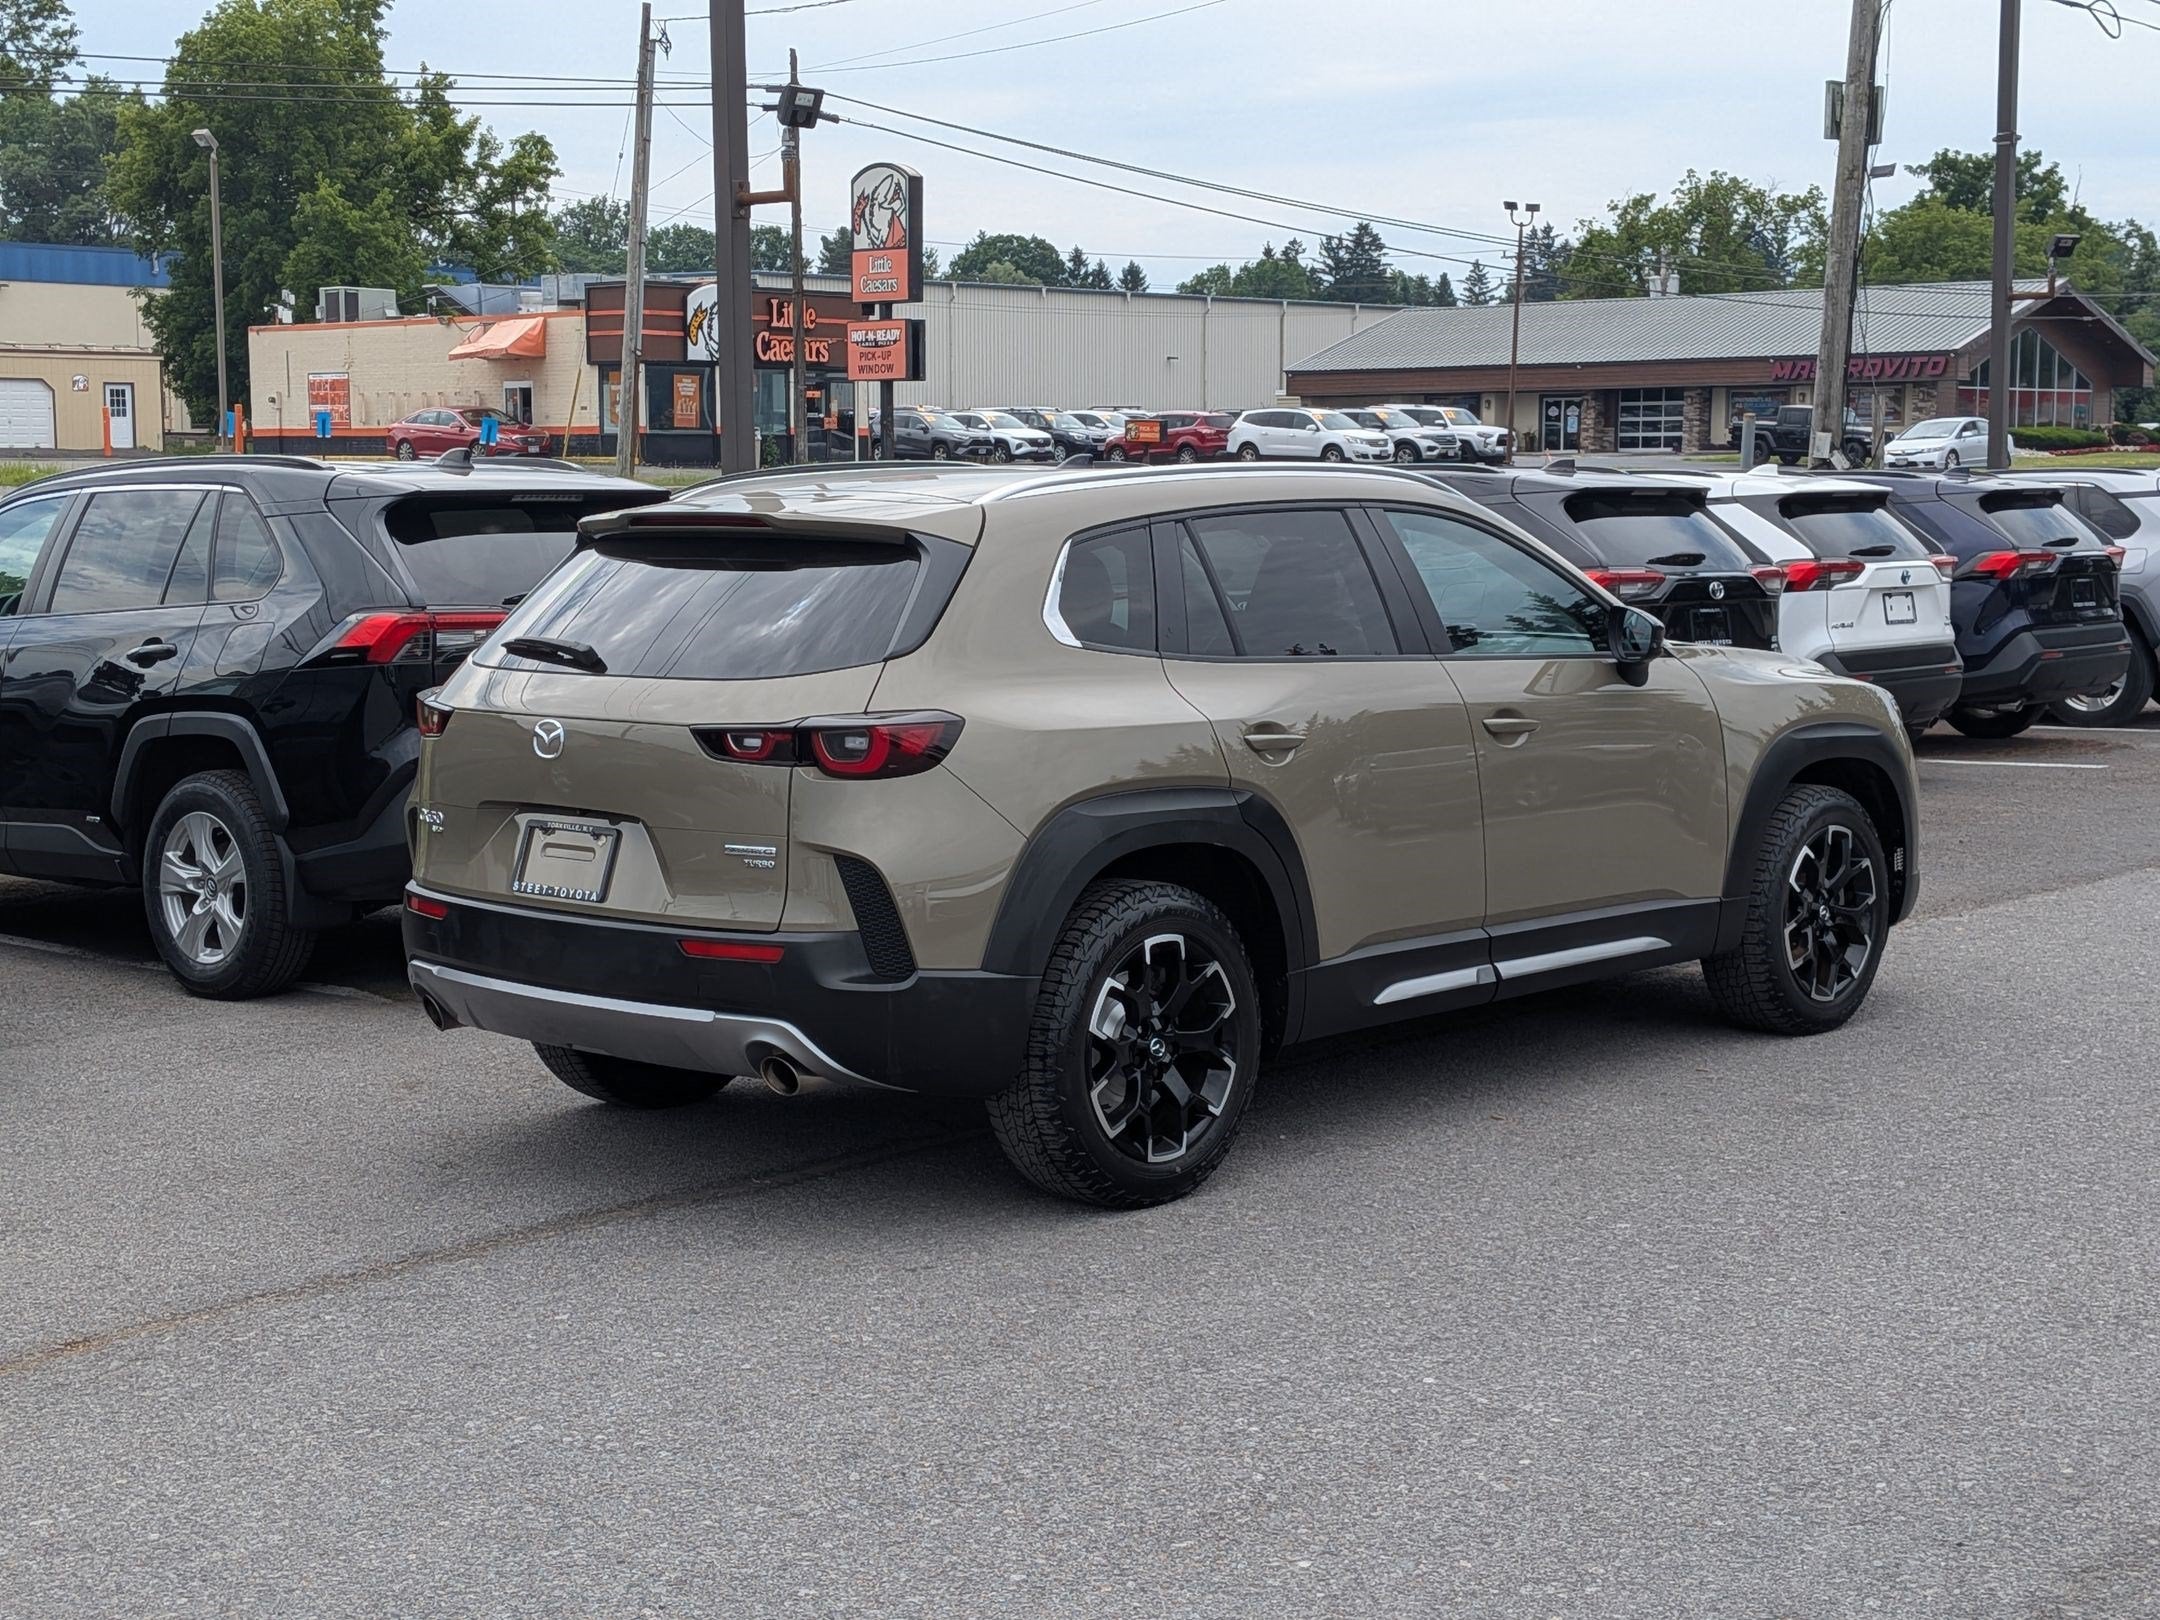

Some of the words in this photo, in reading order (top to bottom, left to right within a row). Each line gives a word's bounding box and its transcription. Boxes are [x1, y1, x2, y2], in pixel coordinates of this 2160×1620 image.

[868, 255, 892, 274] Little
[860, 276, 898, 293] Caesars
[770, 298, 817, 330] Litle
[851, 329, 901, 342] HOT-N-READY
[859, 351, 892, 361] PICK-UP
[858, 364, 894, 374] WINDOW
[1770, 356, 1948, 381] MAROVITO
